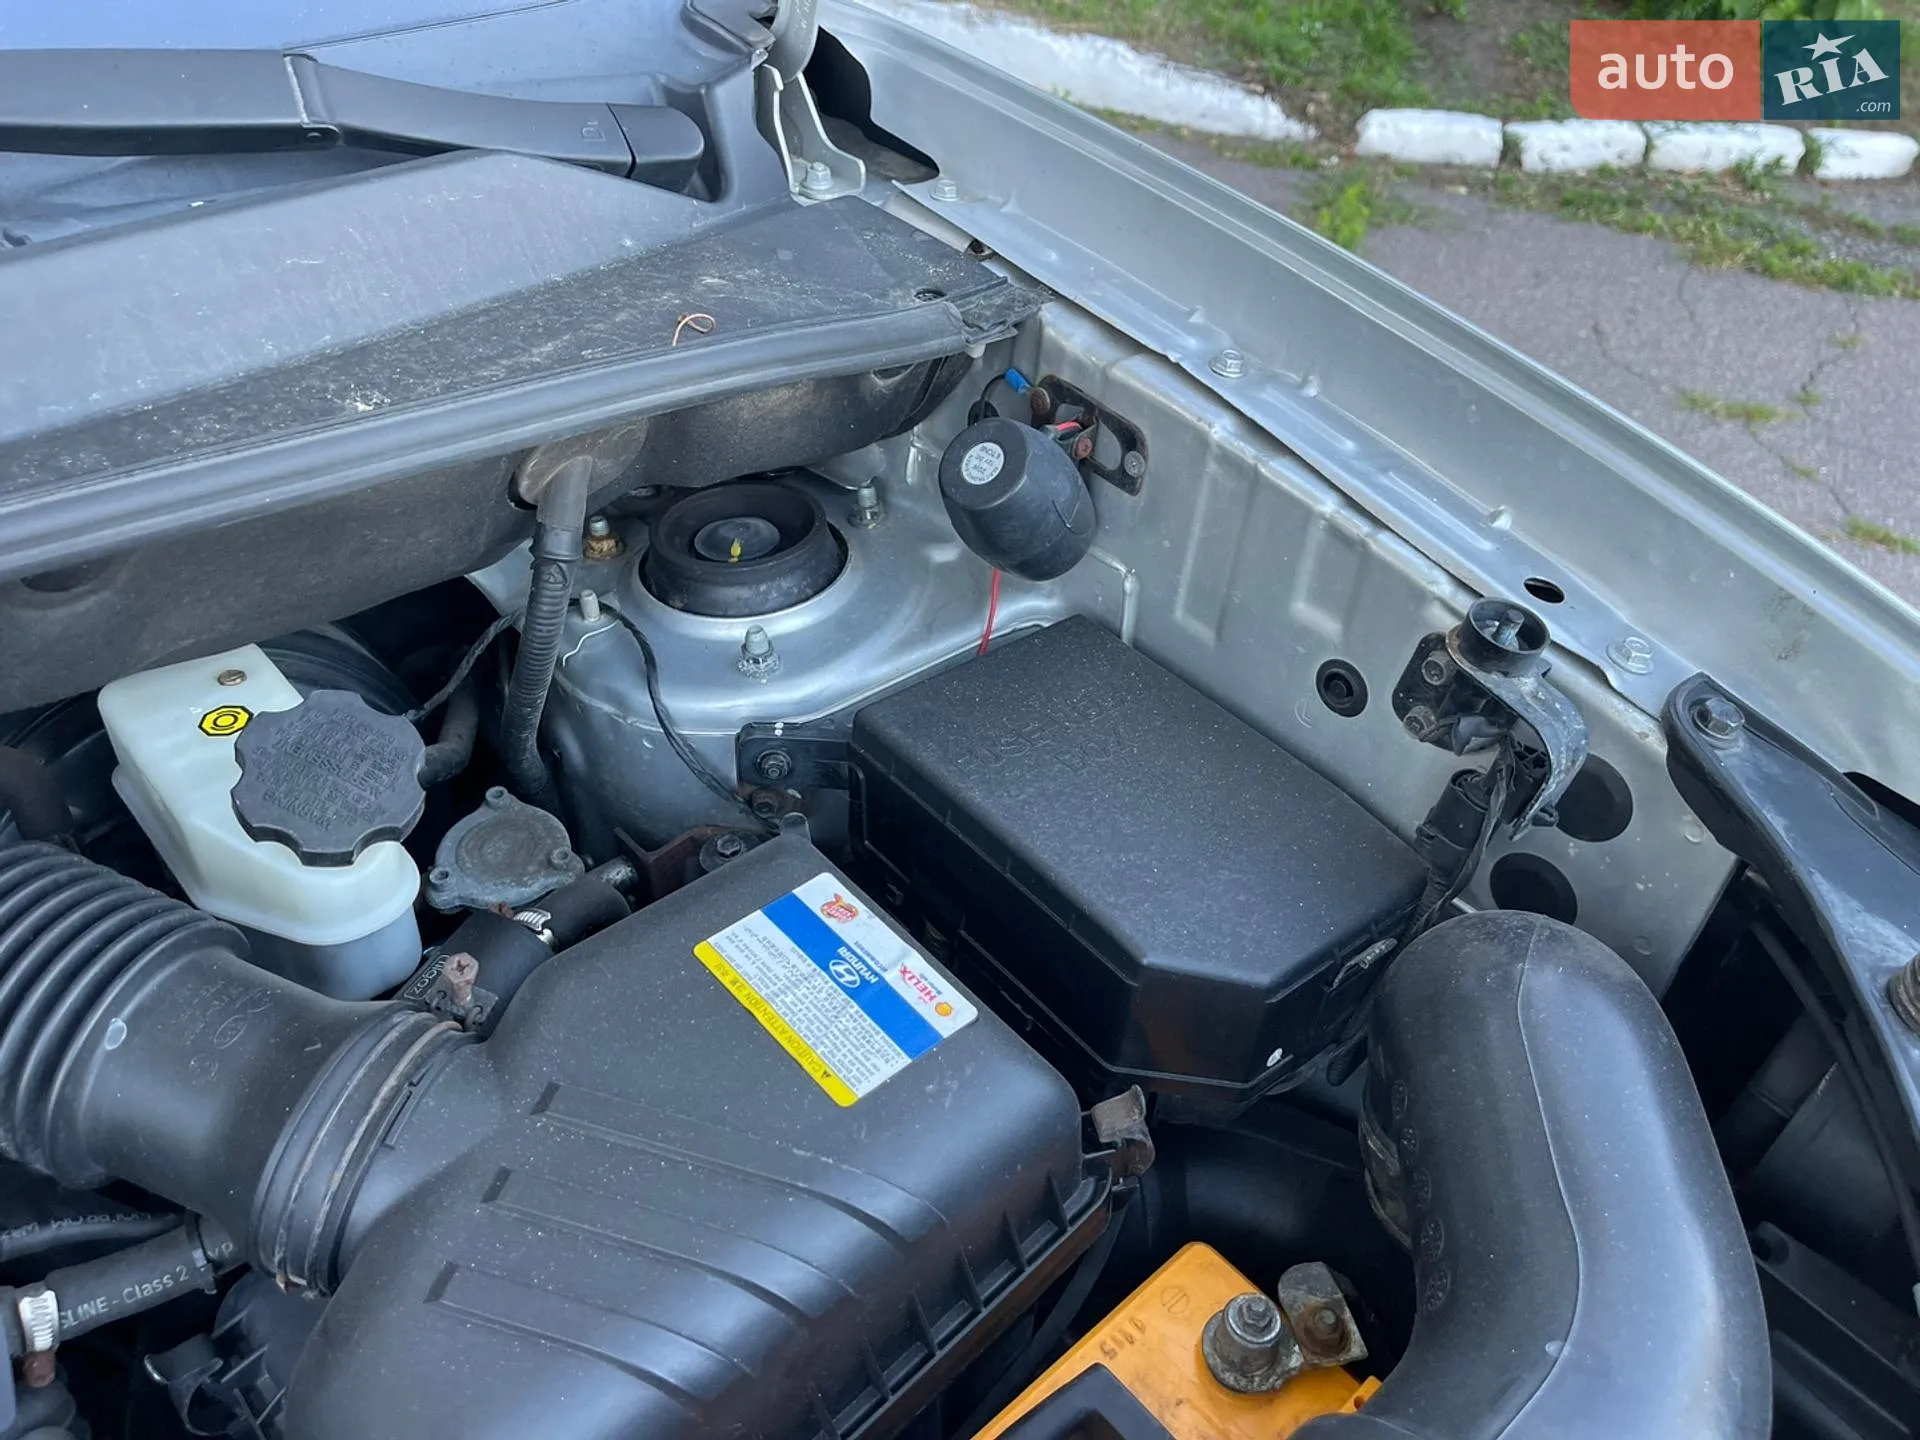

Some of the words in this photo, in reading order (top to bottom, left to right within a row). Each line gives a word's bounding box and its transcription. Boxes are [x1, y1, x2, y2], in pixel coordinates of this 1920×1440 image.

[837, 945, 879, 984] HYUNDAI
[896, 962, 938, 1003] HELIX
[122, 1272, 174, 1305] Class
[175, 1265, 190, 1282] 2
